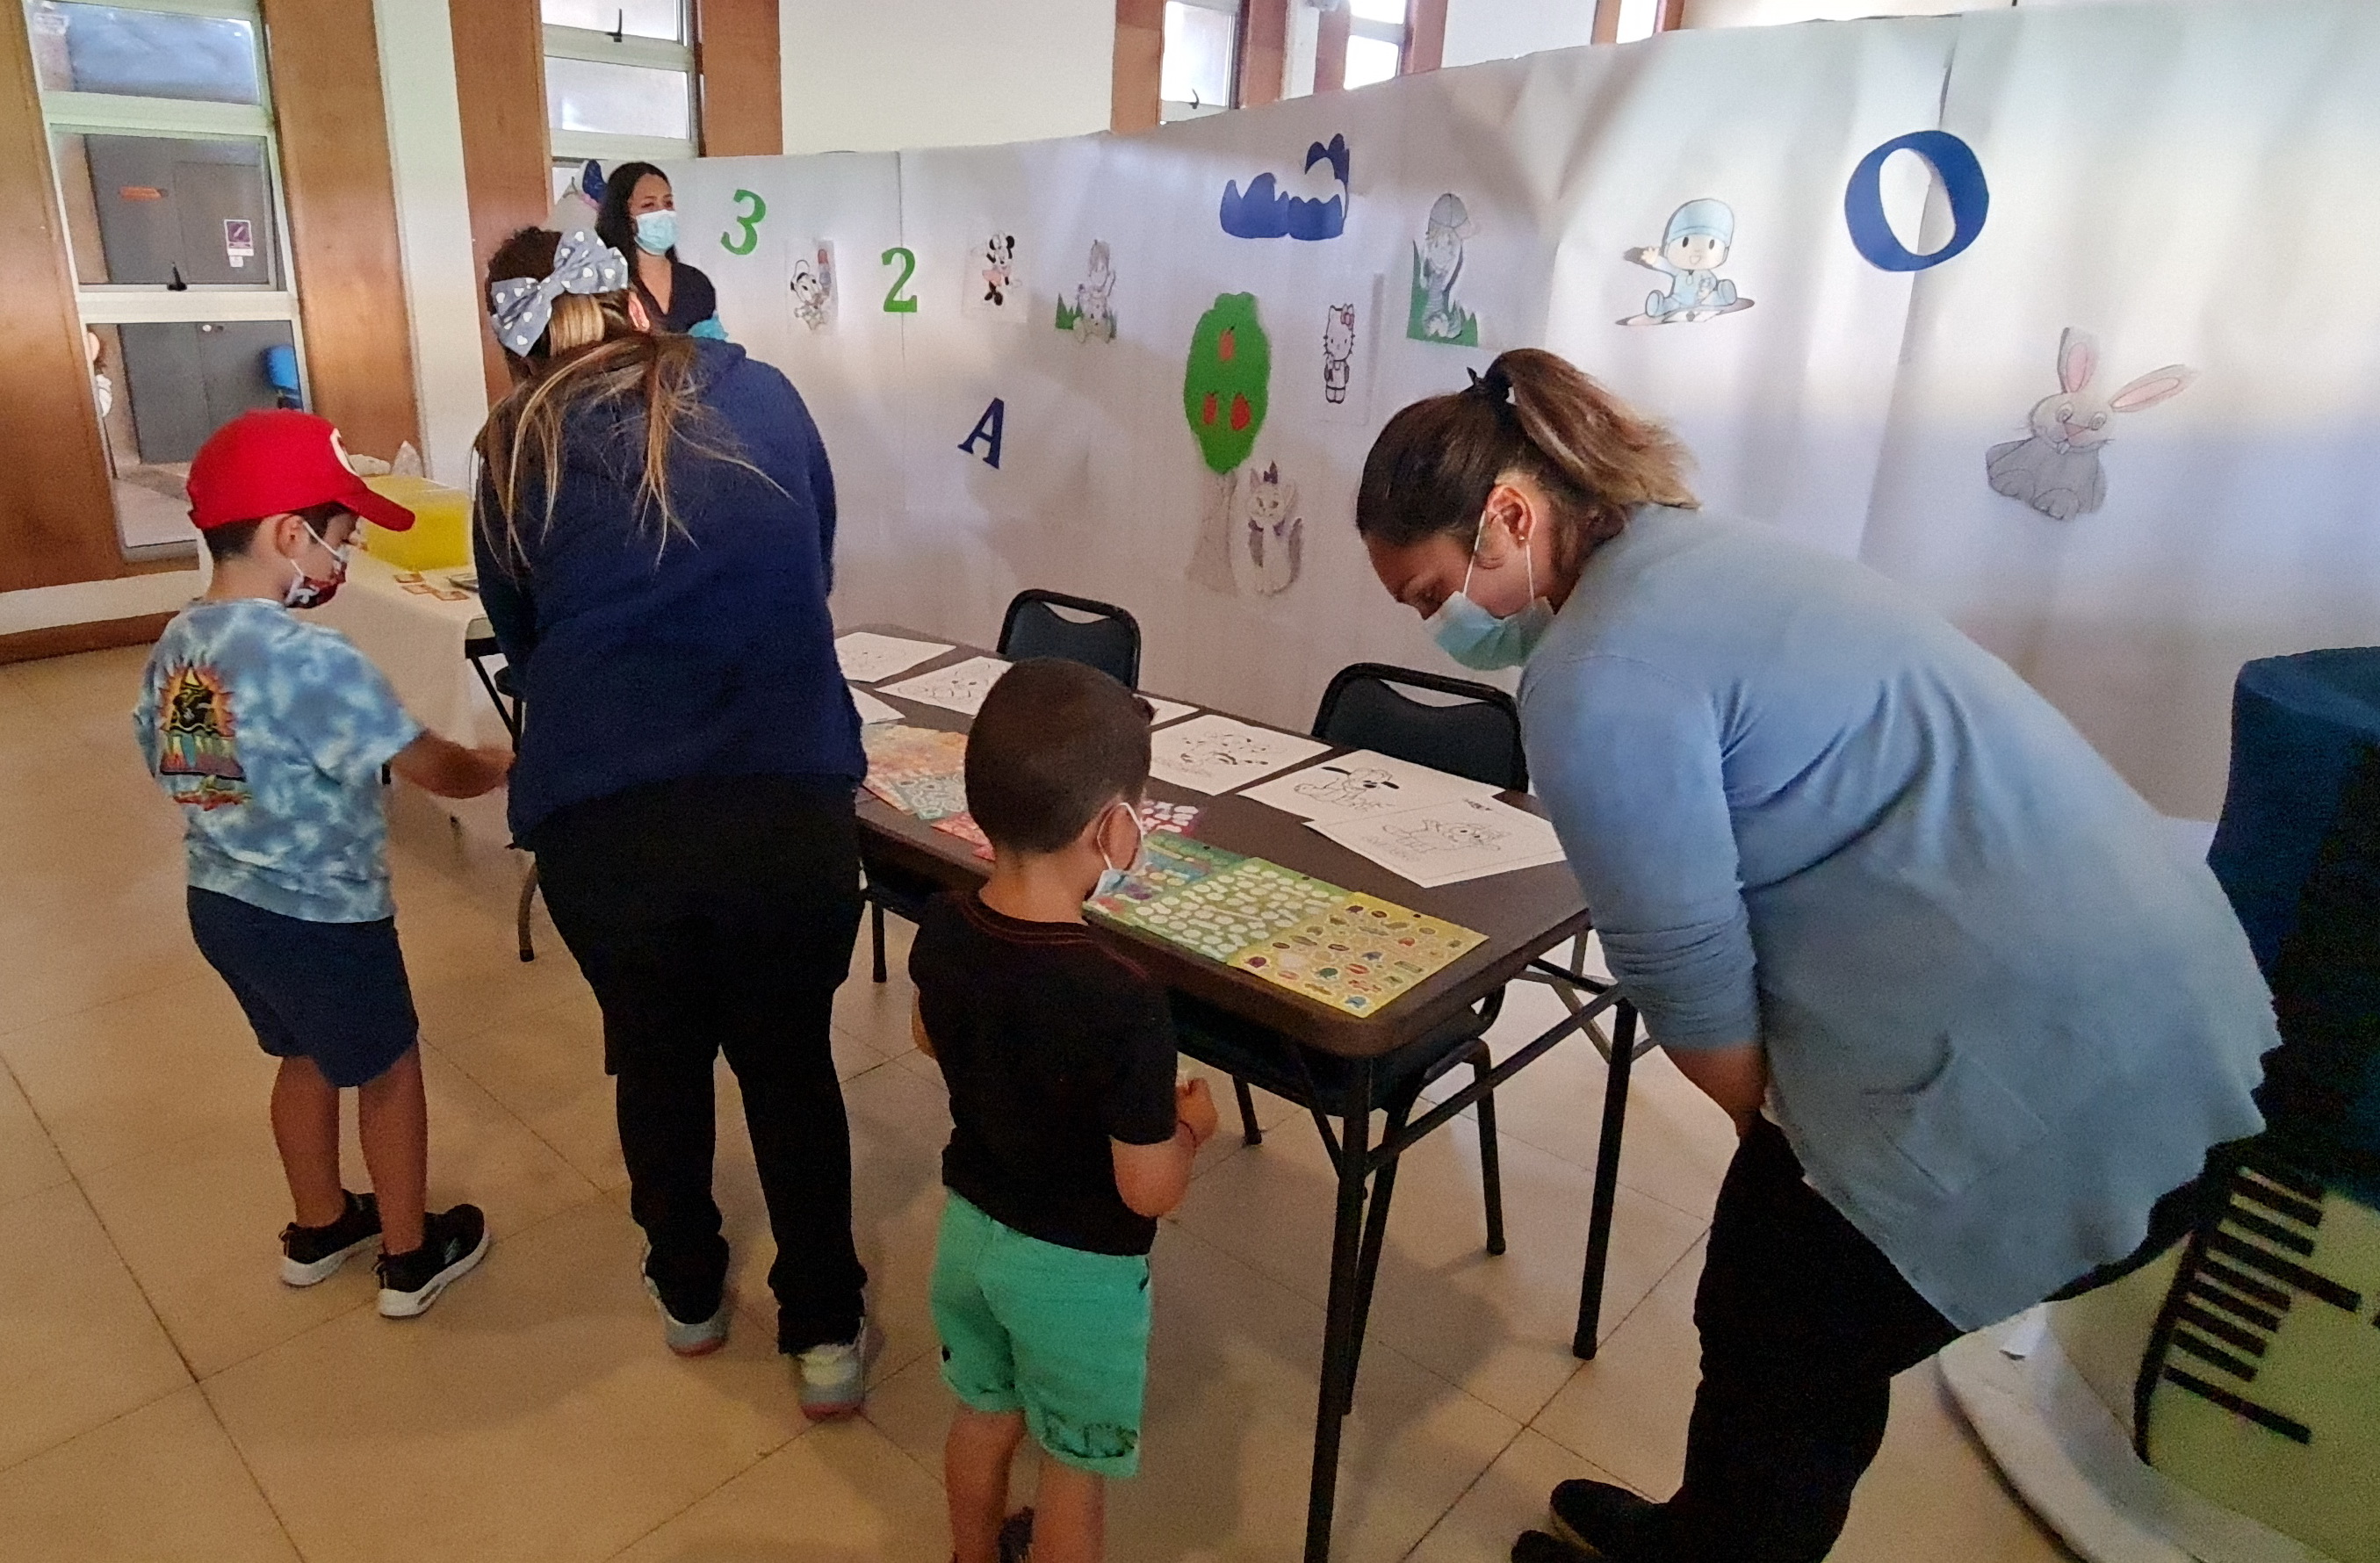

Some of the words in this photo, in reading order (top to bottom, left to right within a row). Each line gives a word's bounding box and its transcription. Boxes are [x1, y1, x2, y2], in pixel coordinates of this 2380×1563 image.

[720, 189, 767, 256] 3
[1844, 130, 1989, 272] O
[880, 247, 918, 313] 2
[957, 397, 1005, 469] A
